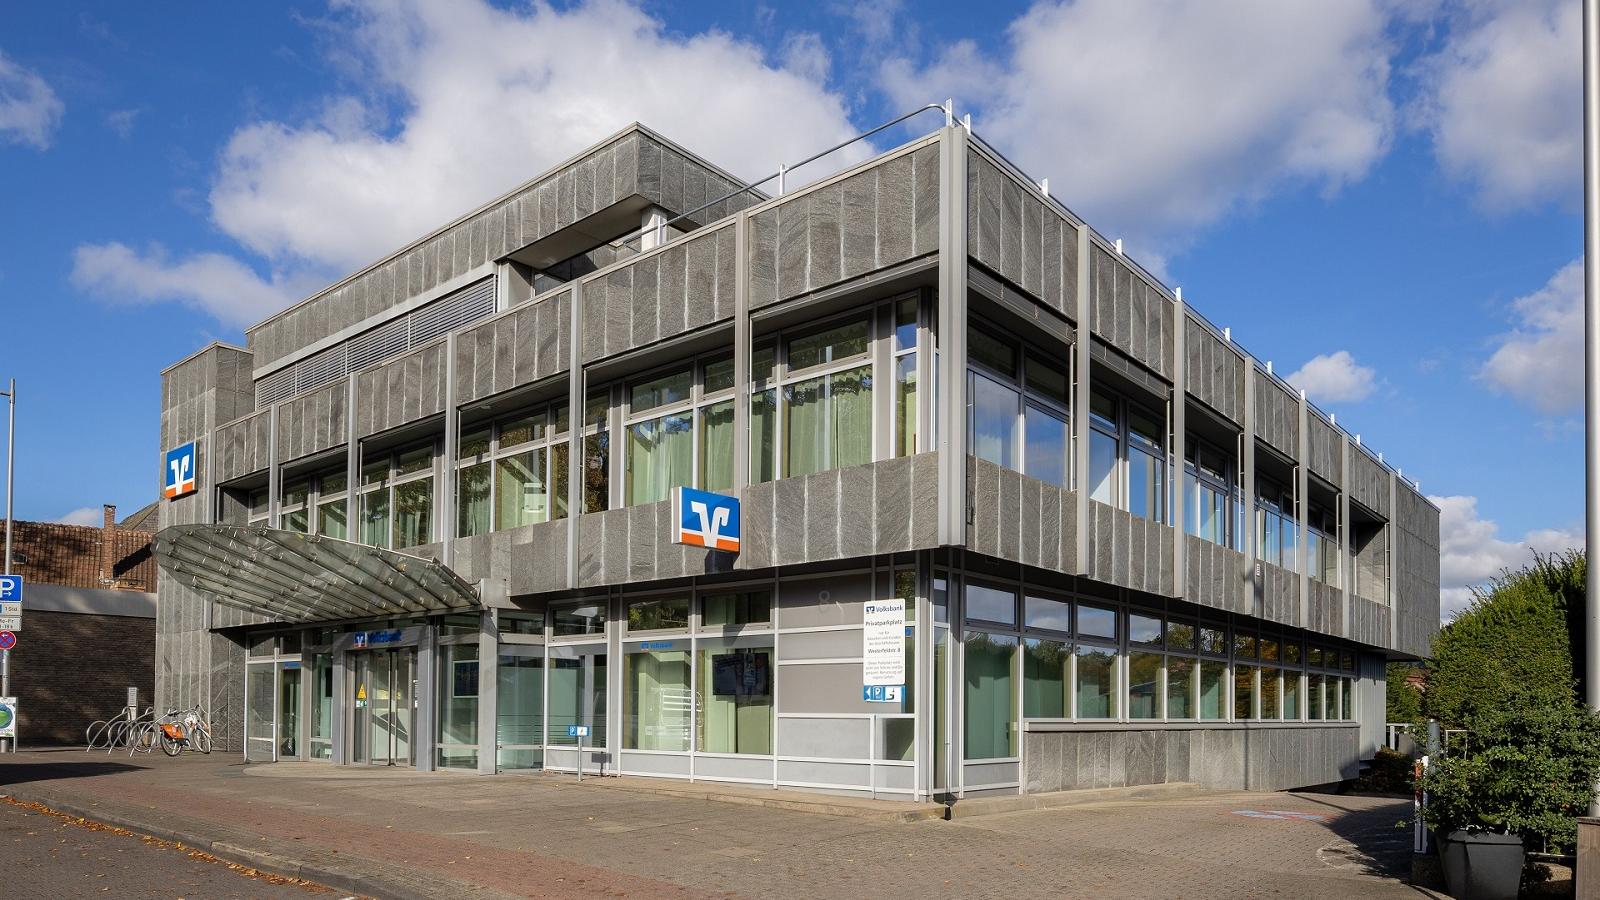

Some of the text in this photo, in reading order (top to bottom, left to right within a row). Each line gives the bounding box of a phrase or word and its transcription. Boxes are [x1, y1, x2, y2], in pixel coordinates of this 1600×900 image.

[0, 578, 14, 598] P
[876, 604, 902, 612] Volksbank
[865, 618, 902, 626] Privatparkplatz
